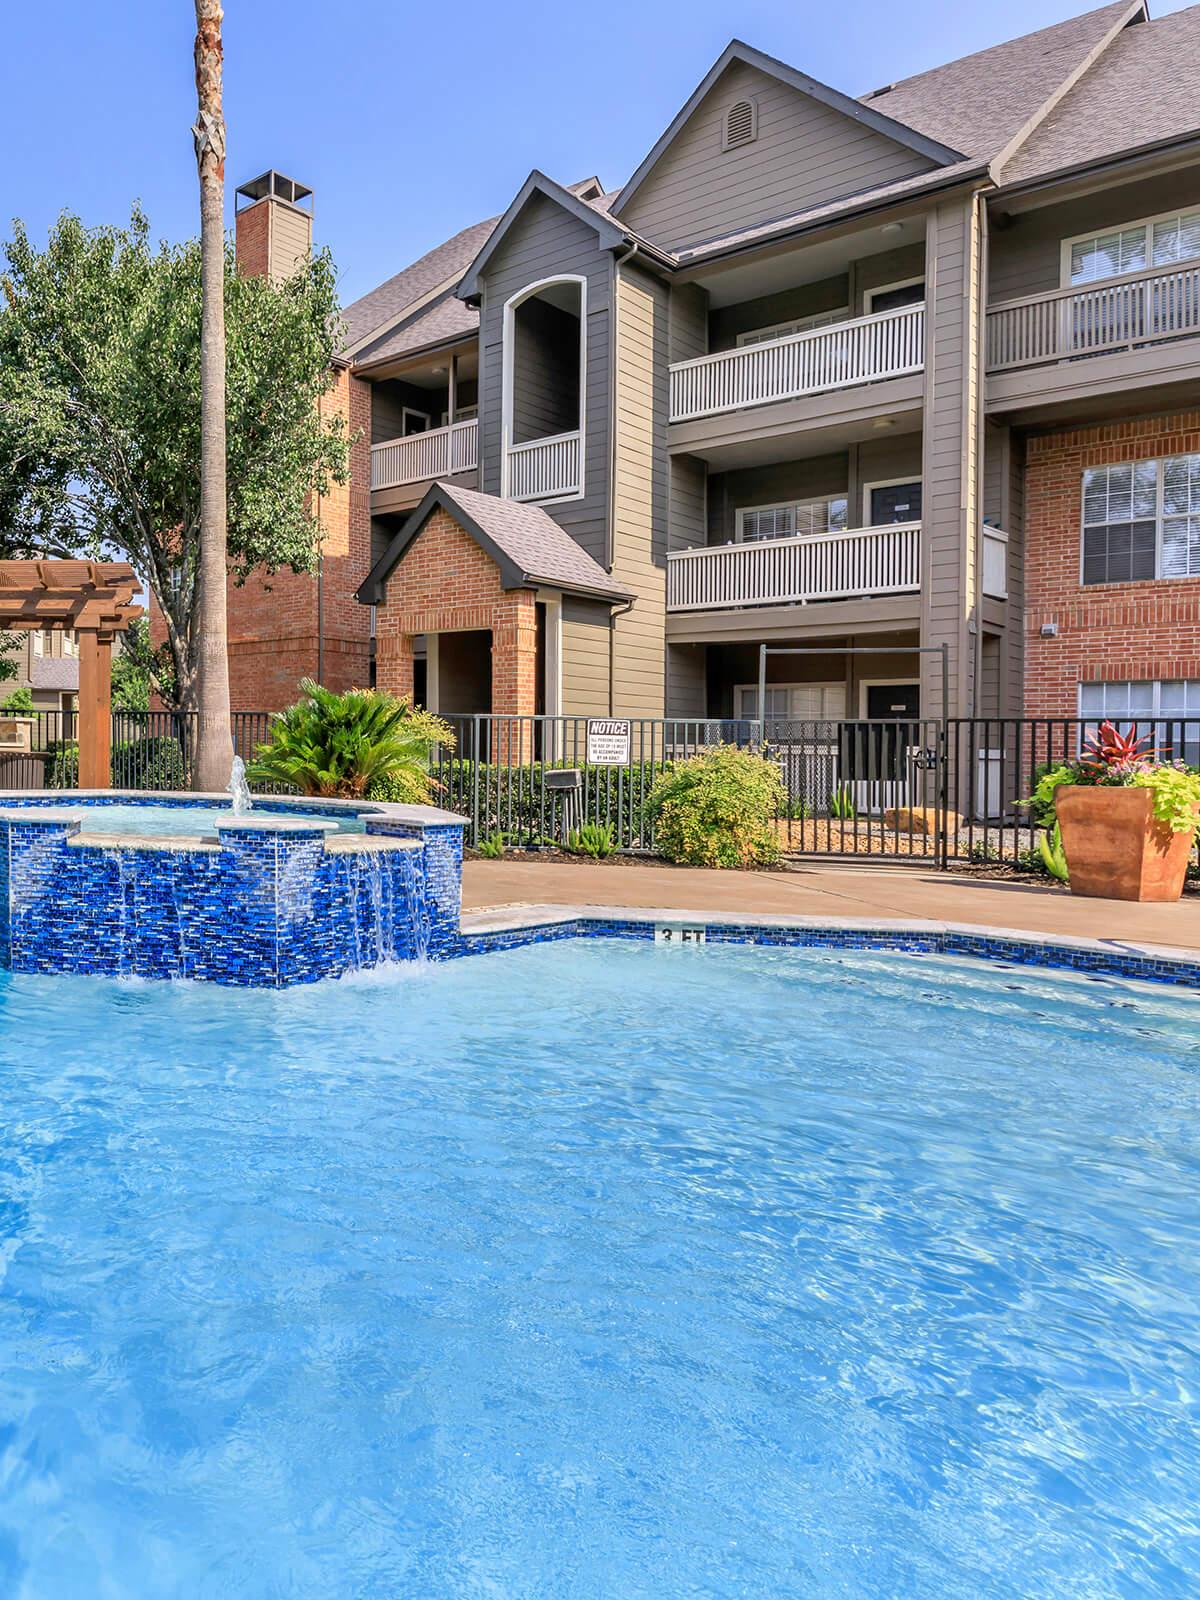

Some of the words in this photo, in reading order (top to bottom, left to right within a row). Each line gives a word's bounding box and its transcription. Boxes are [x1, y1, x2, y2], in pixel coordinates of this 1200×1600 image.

[590, 722, 627, 734] NOTICE
[662, 928, 672, 941] 3
[682, 929, 704, 942] FT
